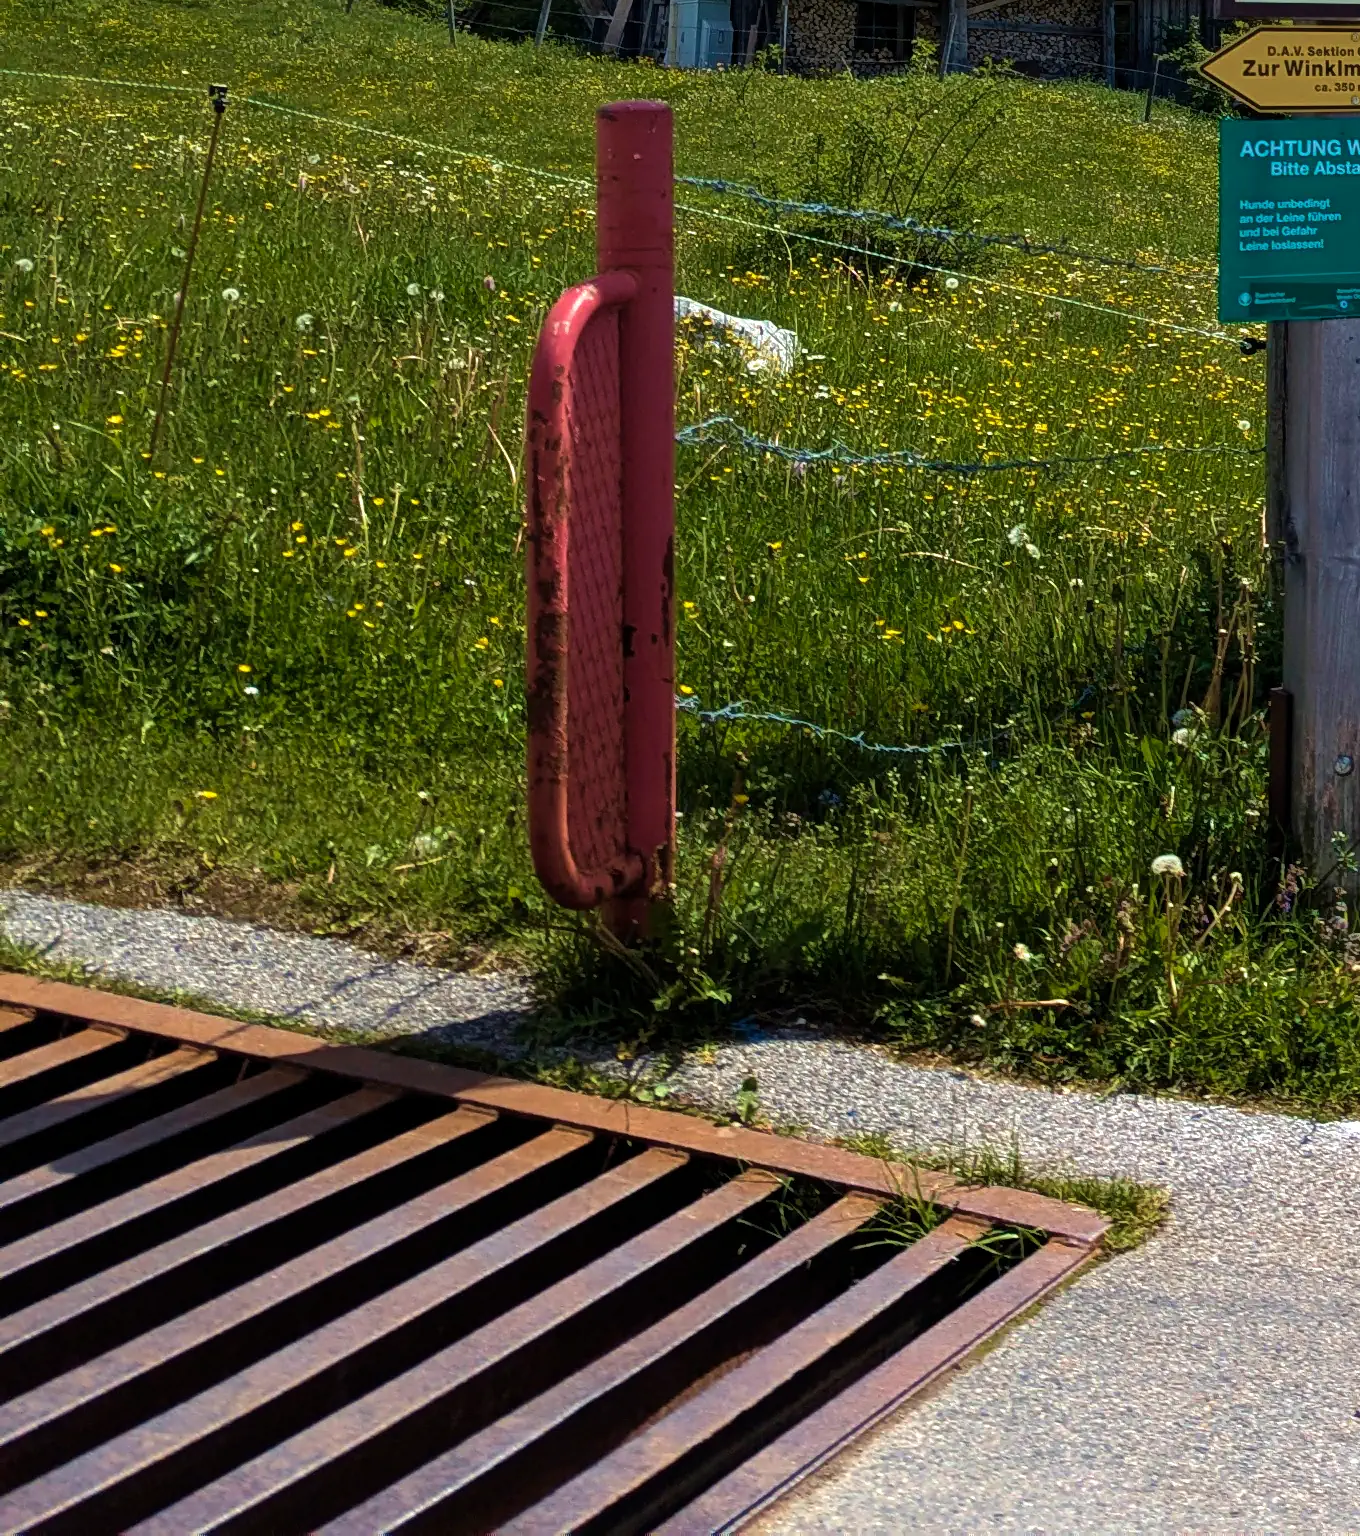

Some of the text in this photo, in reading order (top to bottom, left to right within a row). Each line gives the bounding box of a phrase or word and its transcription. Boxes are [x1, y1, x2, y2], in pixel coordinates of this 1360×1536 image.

[1267, 46, 1304, 57] D.A.V.
[1307, 46, 1354, 58] Sektion
[1242, 59, 1280, 78] Zur
[1315, 83, 1332, 92] ca.
[1334, 82, 1355, 92] 350
[1239, 139, 1341, 158] ACHTUNG
[1271, 161, 1309, 177] Bitte
[1240, 198, 1330, 209] Hunde unbedingt
[1256, 214, 1274, 223] der
[1276, 212, 1305, 222] Leine
[1308, 212, 1342, 221] führen
[1240, 226, 1318, 237] und bei Gefahr
[1240, 241, 1269, 251] Leine
